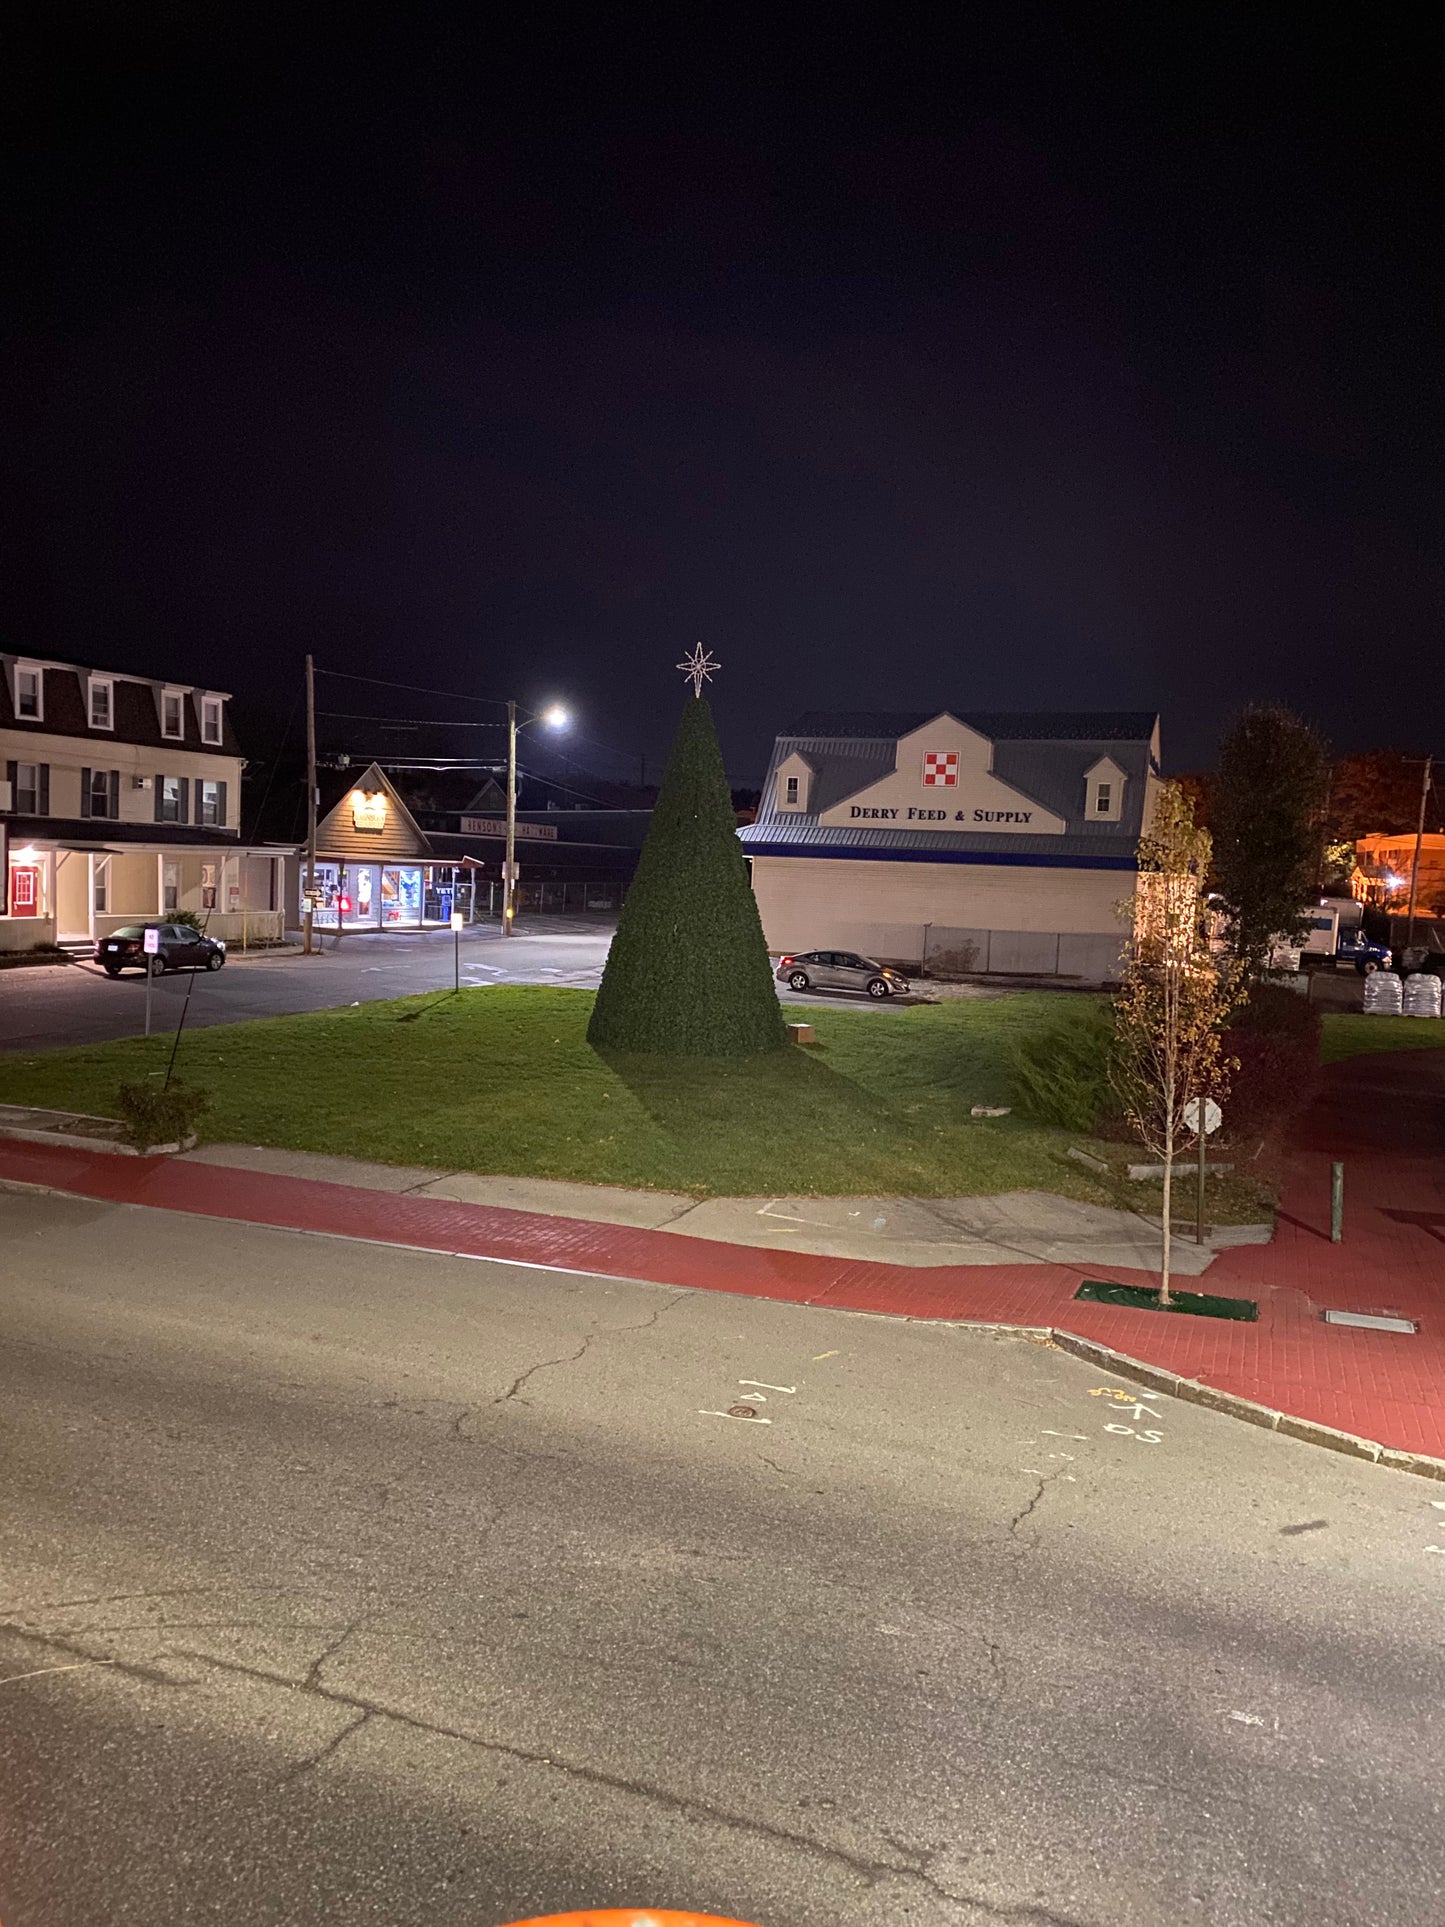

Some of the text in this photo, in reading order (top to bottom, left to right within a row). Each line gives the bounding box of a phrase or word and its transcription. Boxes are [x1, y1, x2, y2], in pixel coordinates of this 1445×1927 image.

[850, 806, 1032, 823] DERRY FEED & SUPPLY
